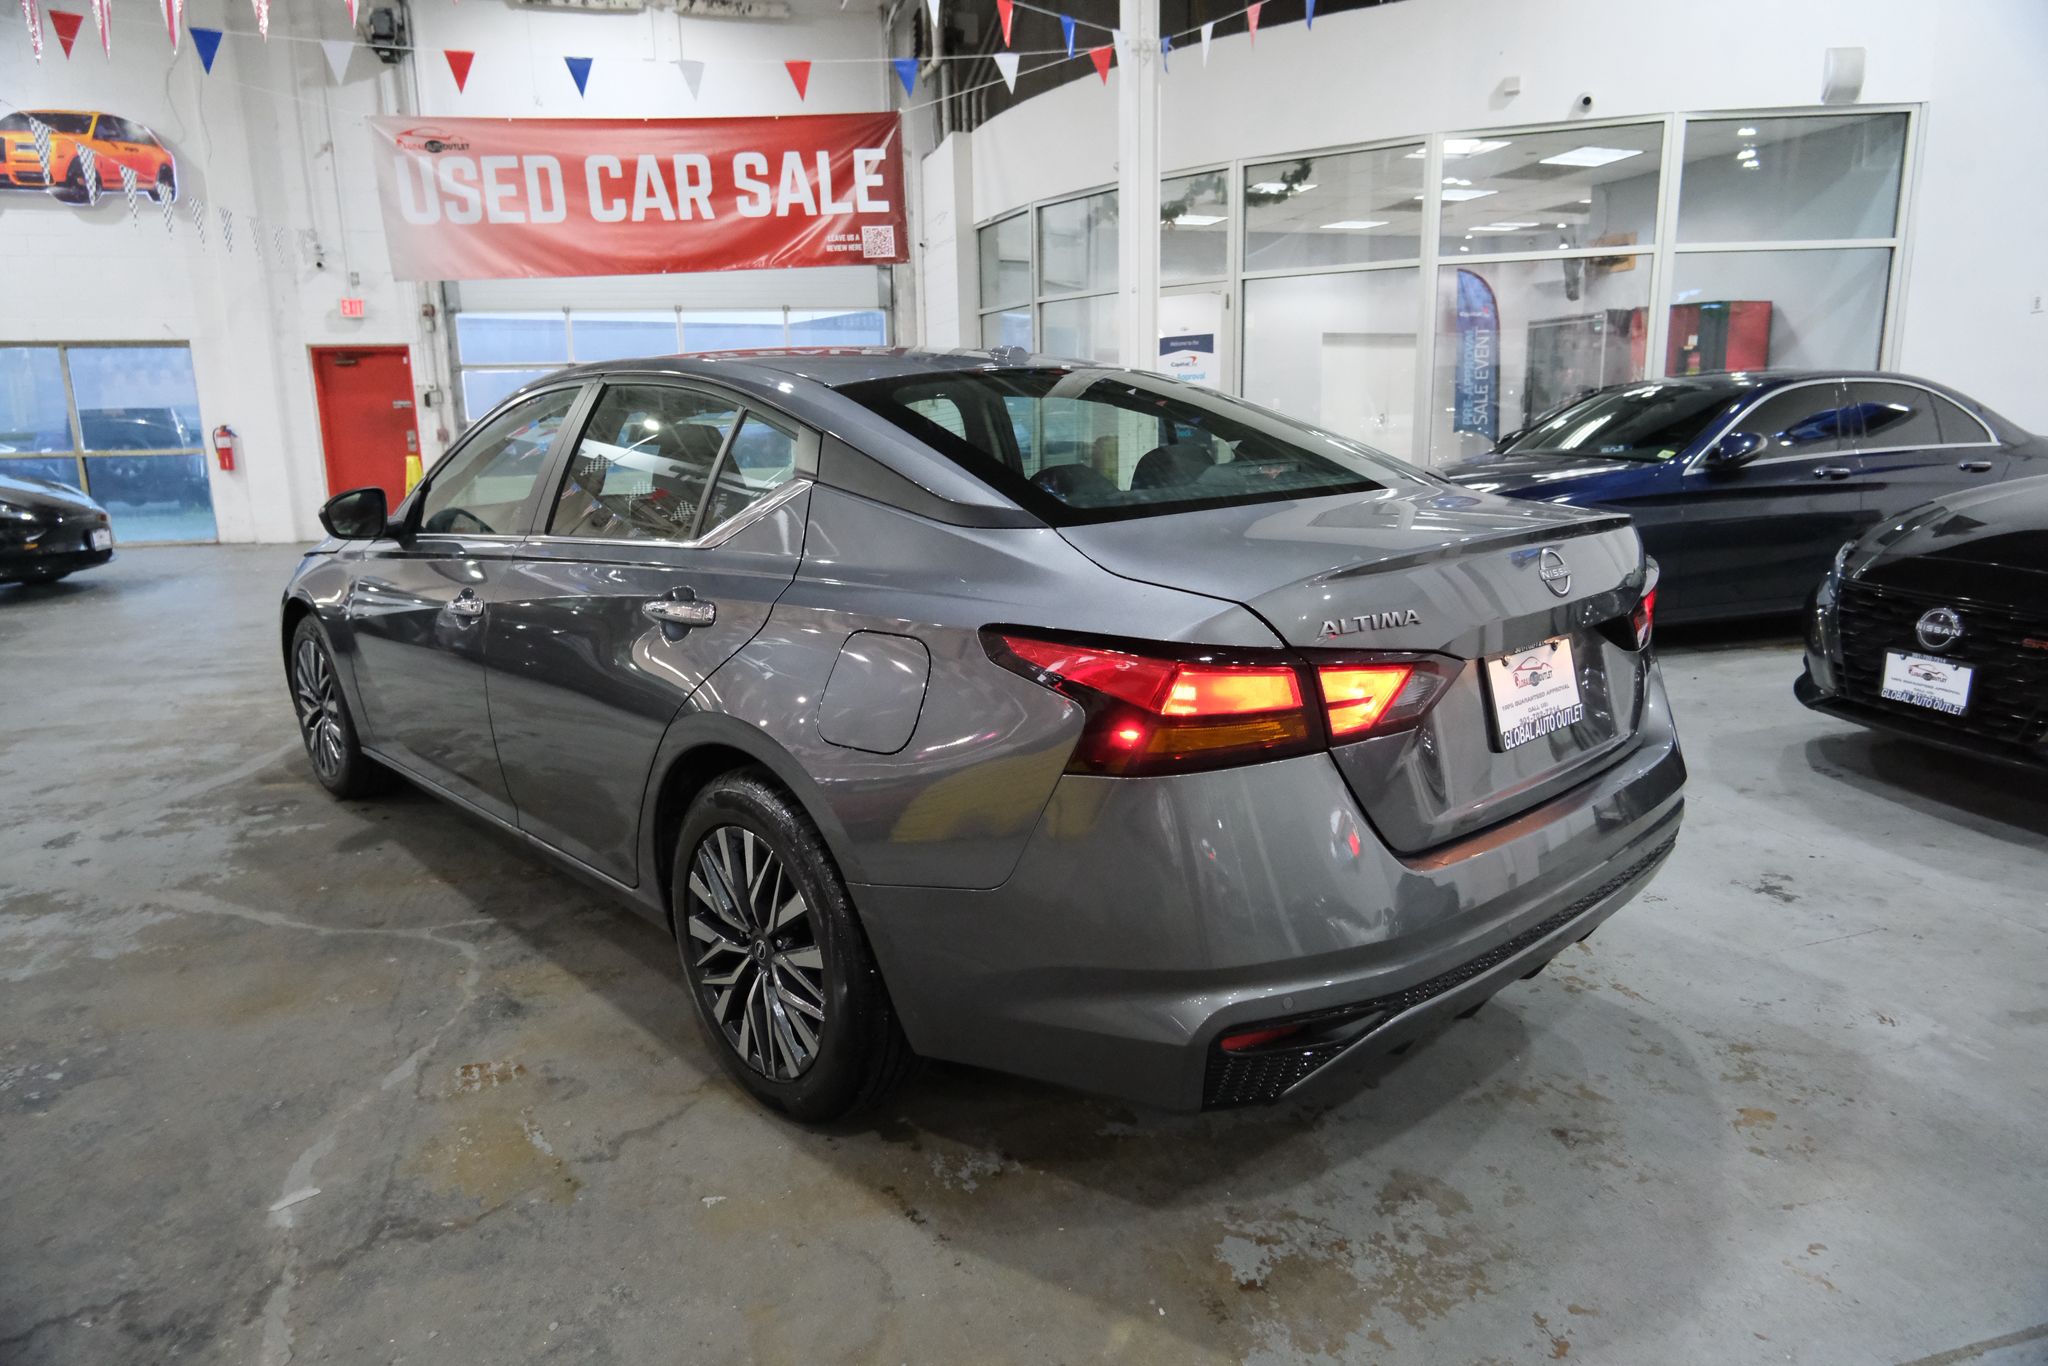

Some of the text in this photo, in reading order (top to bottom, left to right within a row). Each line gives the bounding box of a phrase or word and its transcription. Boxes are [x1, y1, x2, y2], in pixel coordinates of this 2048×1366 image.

[394, 147, 890, 225] USED CAR SALE
[1474, 327, 1490, 380] EVENT
[1473, 384, 1488, 425] SALE
[1318, 609, 1421, 637] ALTIMA
[1915, 621, 1962, 637] NISSAN
[1881, 688, 1911, 702] GLOBAL
[1911, 695, 1933, 708] AUTO
[1933, 699, 1965, 716] OUTLET
[1504, 703, 1584, 750] GLOBAL AUTO OUTLET
